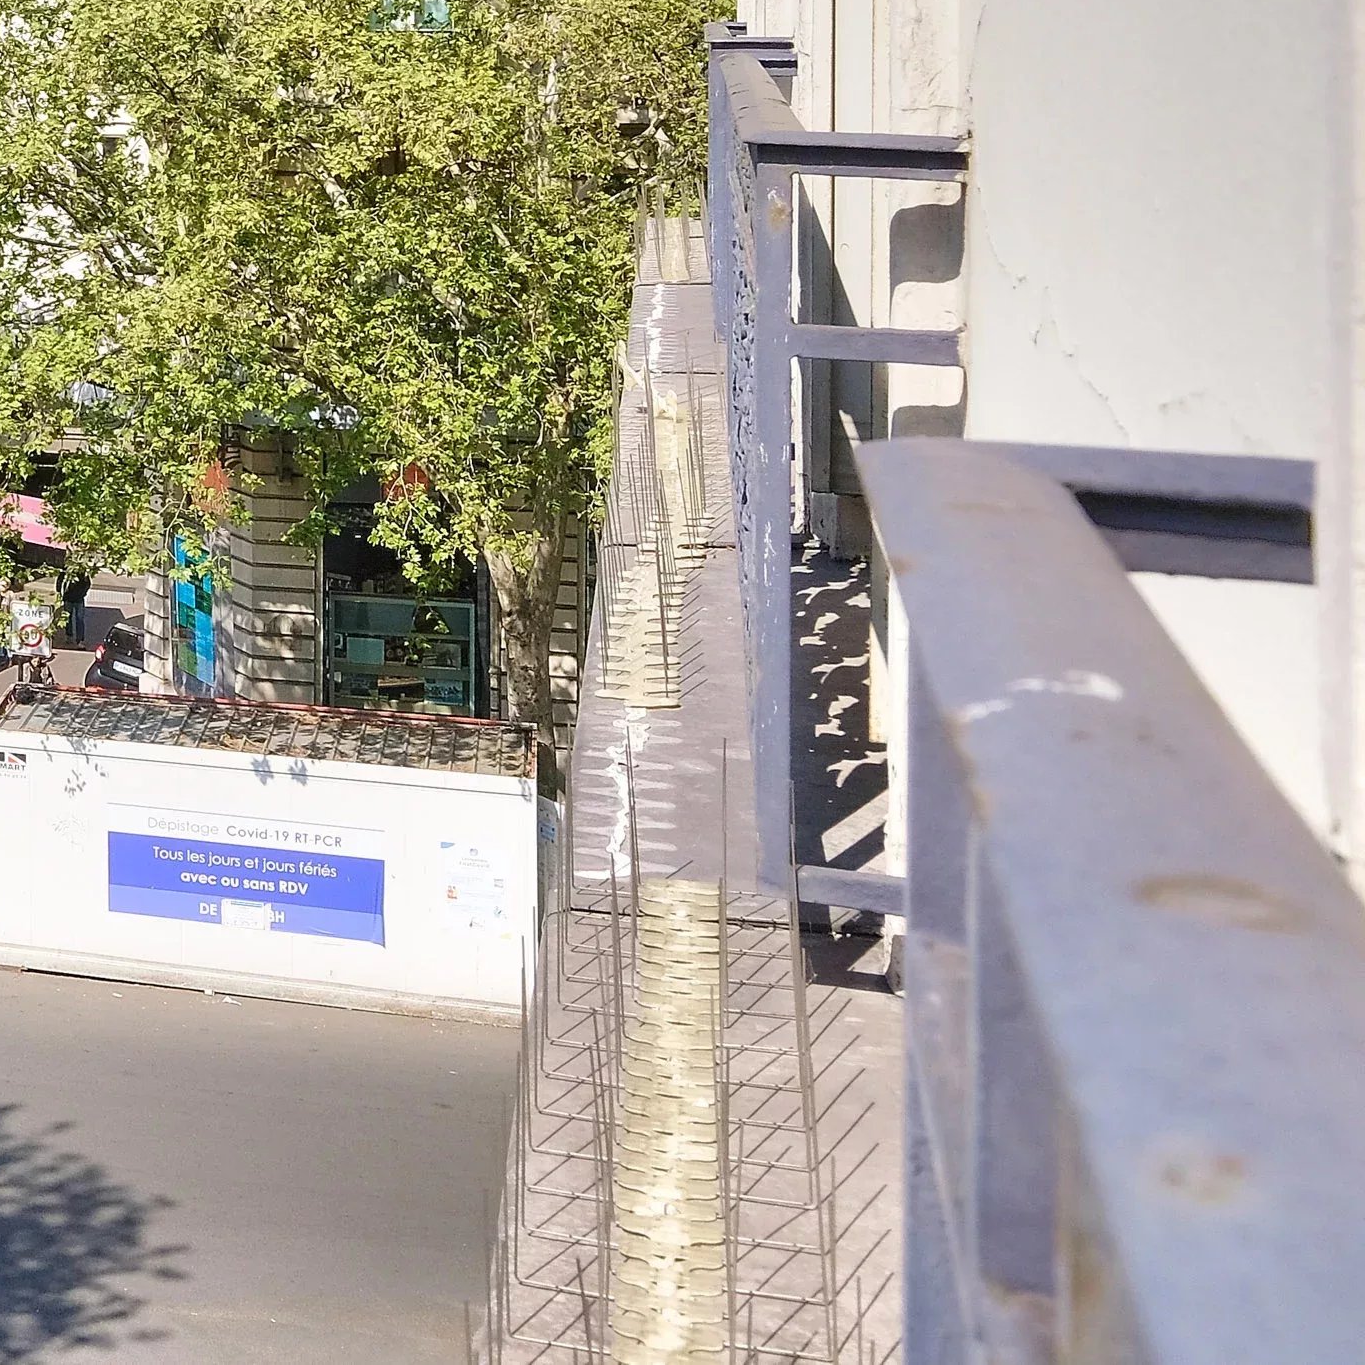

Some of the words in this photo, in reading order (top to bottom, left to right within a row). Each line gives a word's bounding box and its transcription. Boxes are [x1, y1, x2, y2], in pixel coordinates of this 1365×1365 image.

[18, 608, 44, 619] ZONE
[147, 816, 219, 836] Dépistage
[226, 825, 289, 842] Covid-19
[294, 833, 343, 848] RT-PCR
[153, 846, 184, 862] Tous
[186, 850, 206, 864] les
[207, 852, 241, 868] jours
[244, 858, 259, 870] et
[261, 858, 296, 875] jours
[299, 862, 338, 878] fériés
[180, 872, 217, 886] avec
[221, 877, 239, 888] ou
[242, 879, 275, 892] sans
[278, 880, 309, 896] RDV
[198, 902, 218, 916] DE
